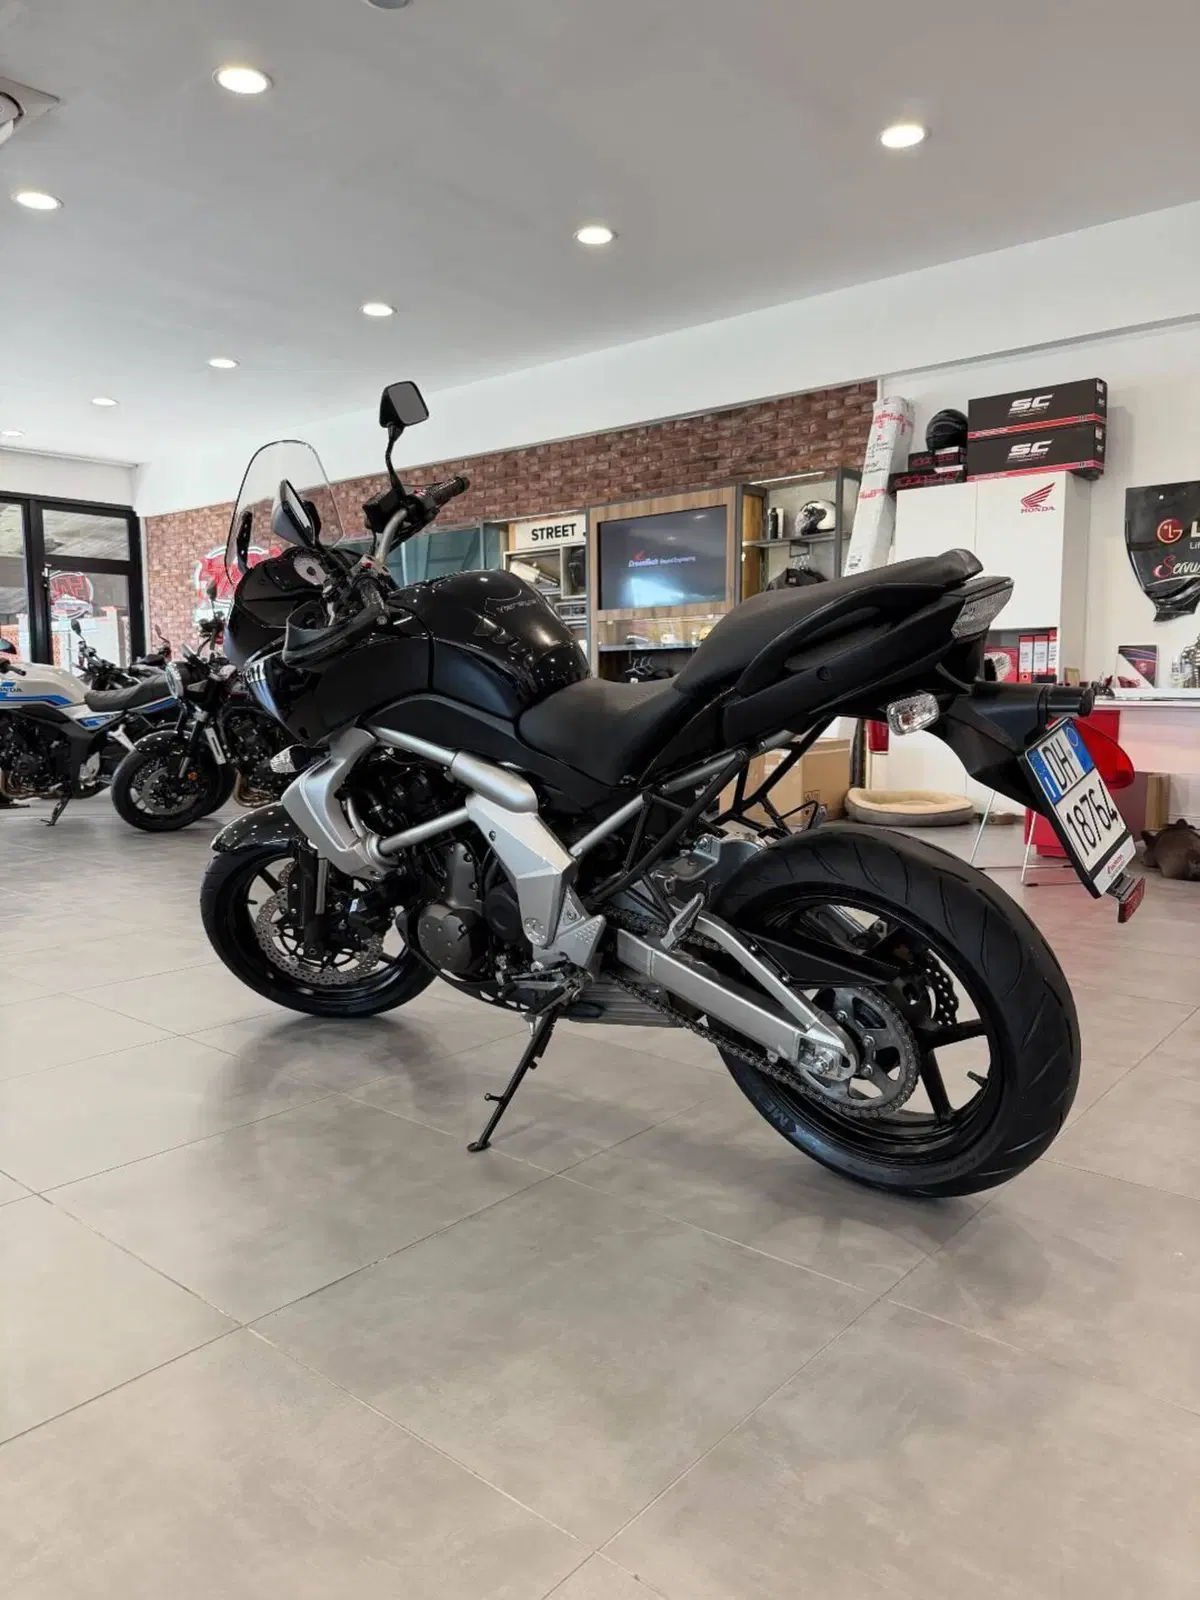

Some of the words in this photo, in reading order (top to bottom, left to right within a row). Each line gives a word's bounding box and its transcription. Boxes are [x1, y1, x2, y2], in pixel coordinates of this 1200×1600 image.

[1010, 394, 1054, 411] SC
[1008, 440, 1053, 457] SC
[1021, 506, 1056, 514] HONDA
[531, 523, 576, 541] STREET
[1042, 738, 1077, 788] DH
[1065, 780, 1118, 856] 18764
